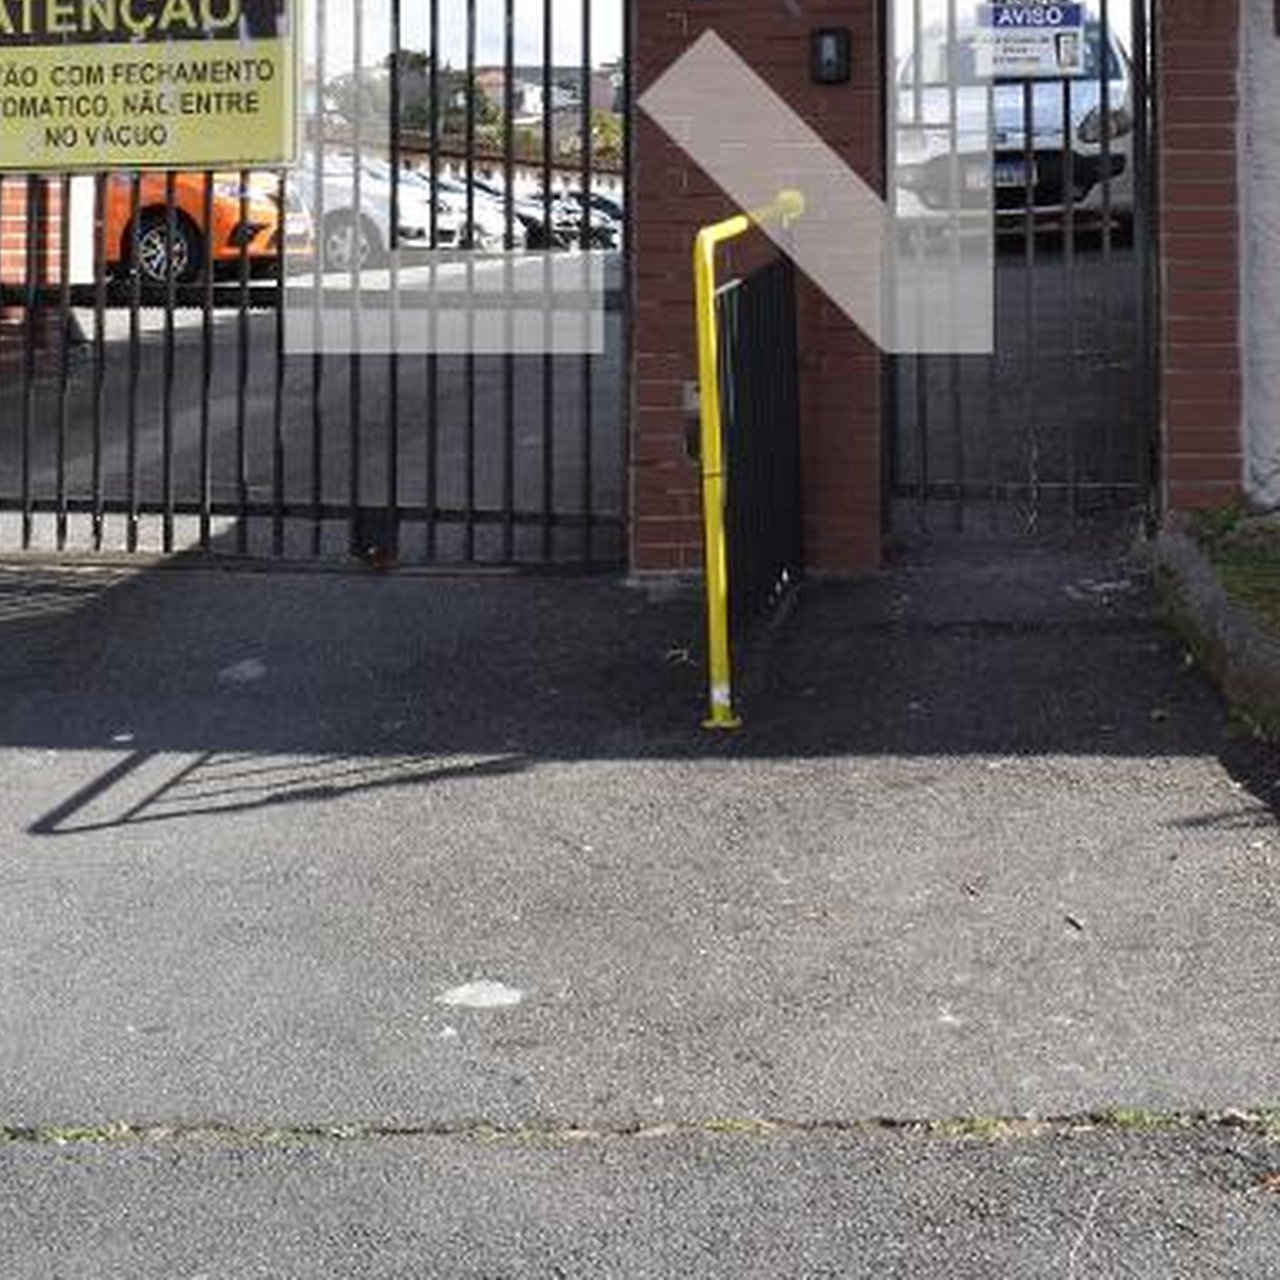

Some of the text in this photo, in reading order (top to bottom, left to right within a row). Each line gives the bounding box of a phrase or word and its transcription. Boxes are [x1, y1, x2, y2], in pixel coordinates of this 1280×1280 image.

[998, 6, 1063, 25] AVISO
[50, 64, 105, 88] COM
[111, 58, 276, 86] FECHAMENTO
[179, 90, 260, 115] ENTRE
[45, 124, 79, 148] NO
